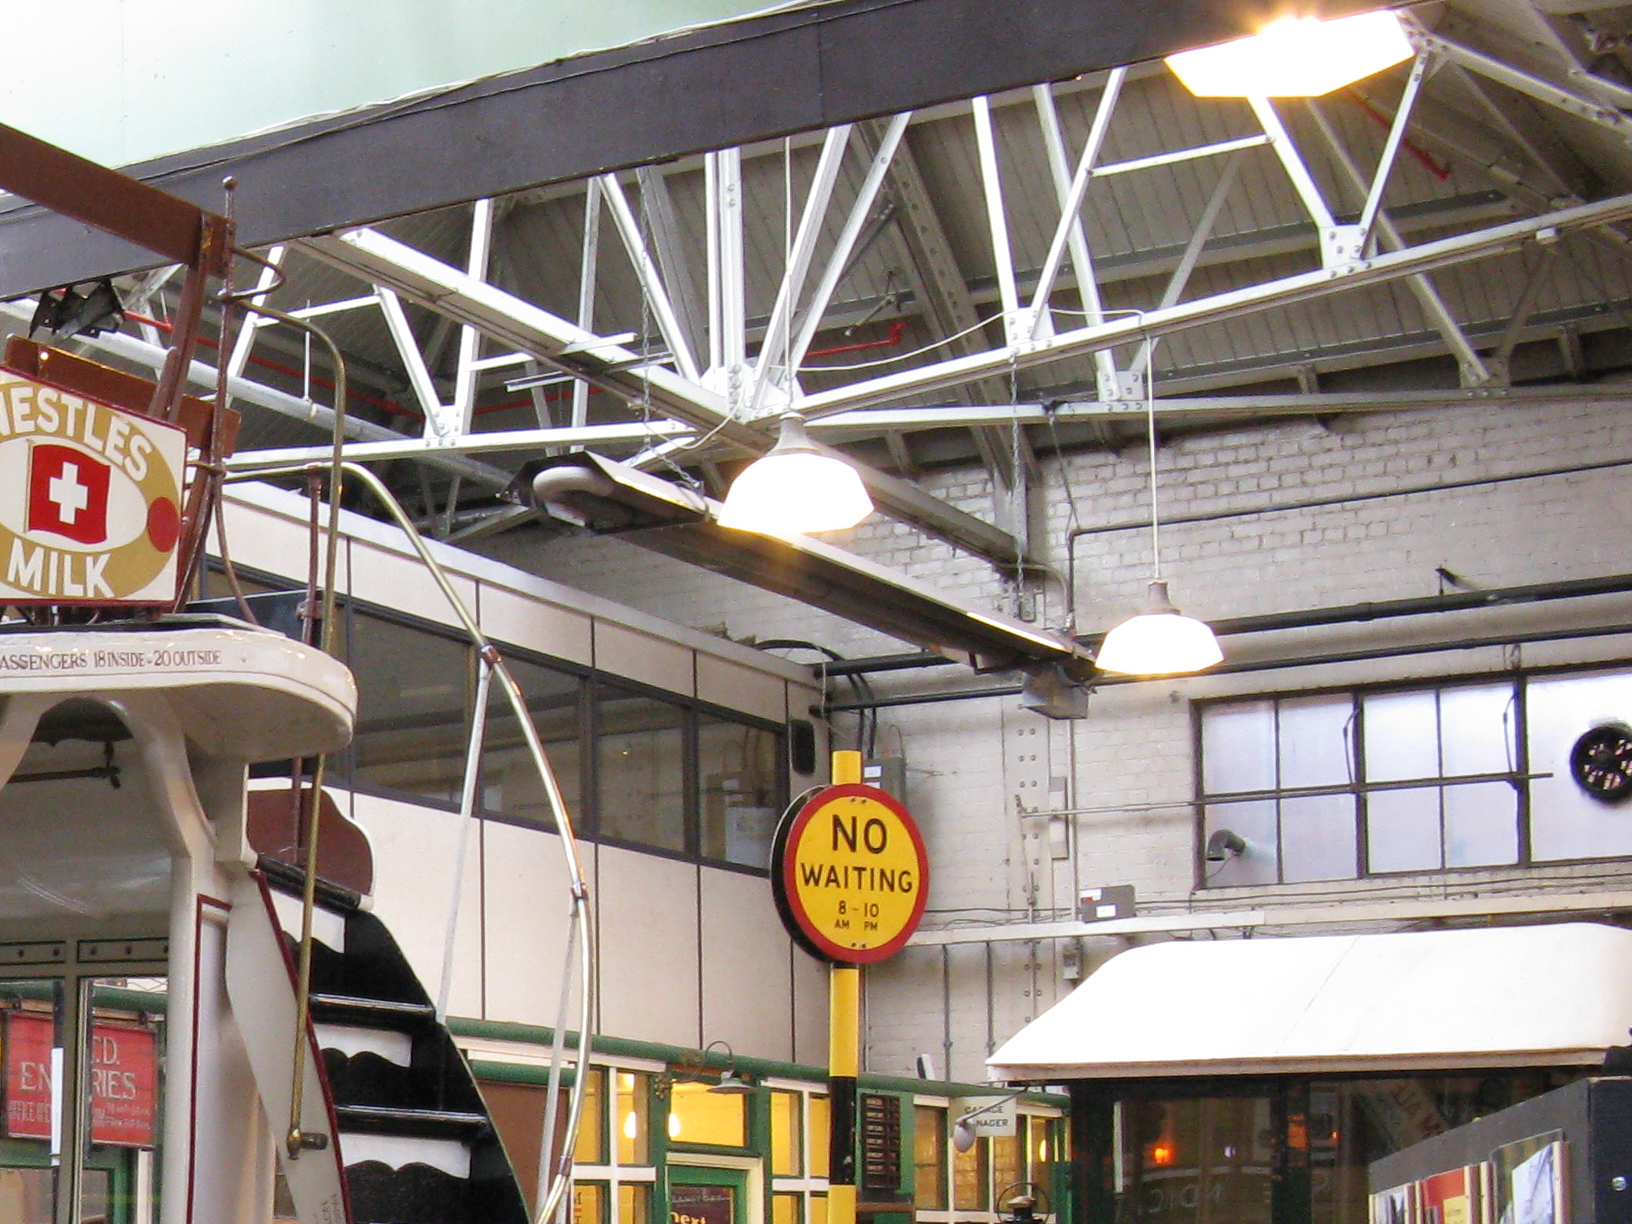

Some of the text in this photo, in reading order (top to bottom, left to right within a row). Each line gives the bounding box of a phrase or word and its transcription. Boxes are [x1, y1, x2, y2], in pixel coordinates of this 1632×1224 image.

[7, 537, 115, 599] MILK
[93, 653, 105, 669] 18
[108, 652, 145, 669] INSIDE
[154, 650, 172, 667] 20
[173, 649, 222, 667] OUTSIDE
[832, 814, 887, 854] NO
[801, 862, 913, 893] WAITING
[838, 901, 846, 915] 8
[864, 903, 879, 917] 10
[834, 919, 878, 931] AM PM
[976, 1119, 1008, 1127] NAGER
